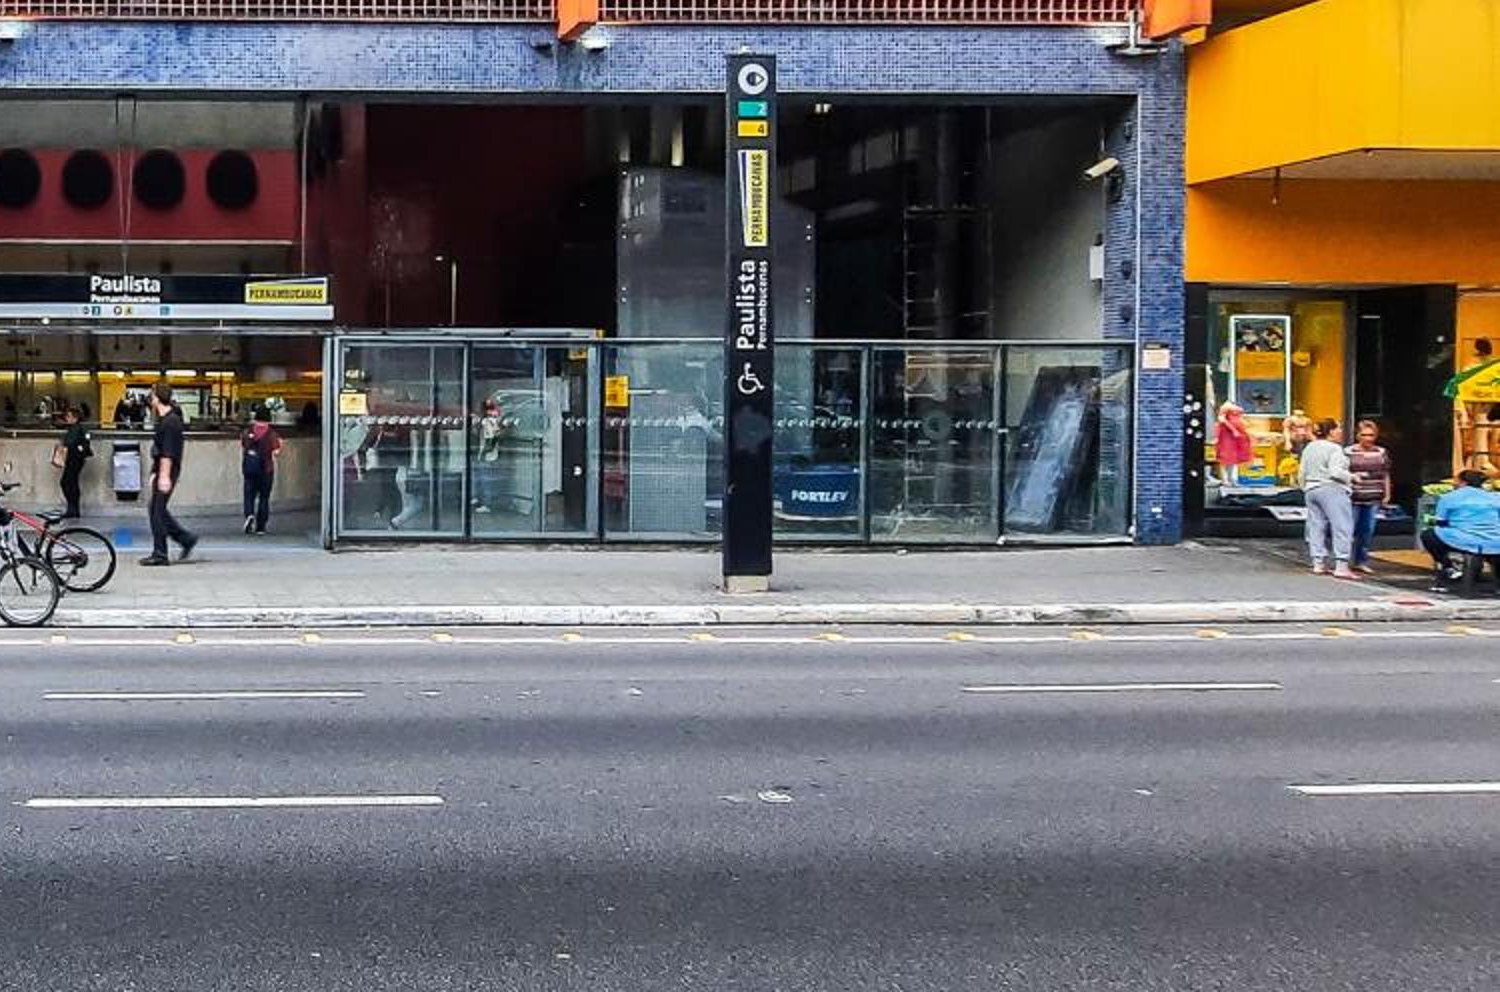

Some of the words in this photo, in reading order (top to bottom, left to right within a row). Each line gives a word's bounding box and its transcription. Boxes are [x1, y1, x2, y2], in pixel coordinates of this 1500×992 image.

[751, 153, 763, 243] PERNAMBUCANAS
[90, 275, 162, 293] Paulista
[735, 260, 755, 350] Paulista
[756, 260, 768, 350] Pernambucanas
